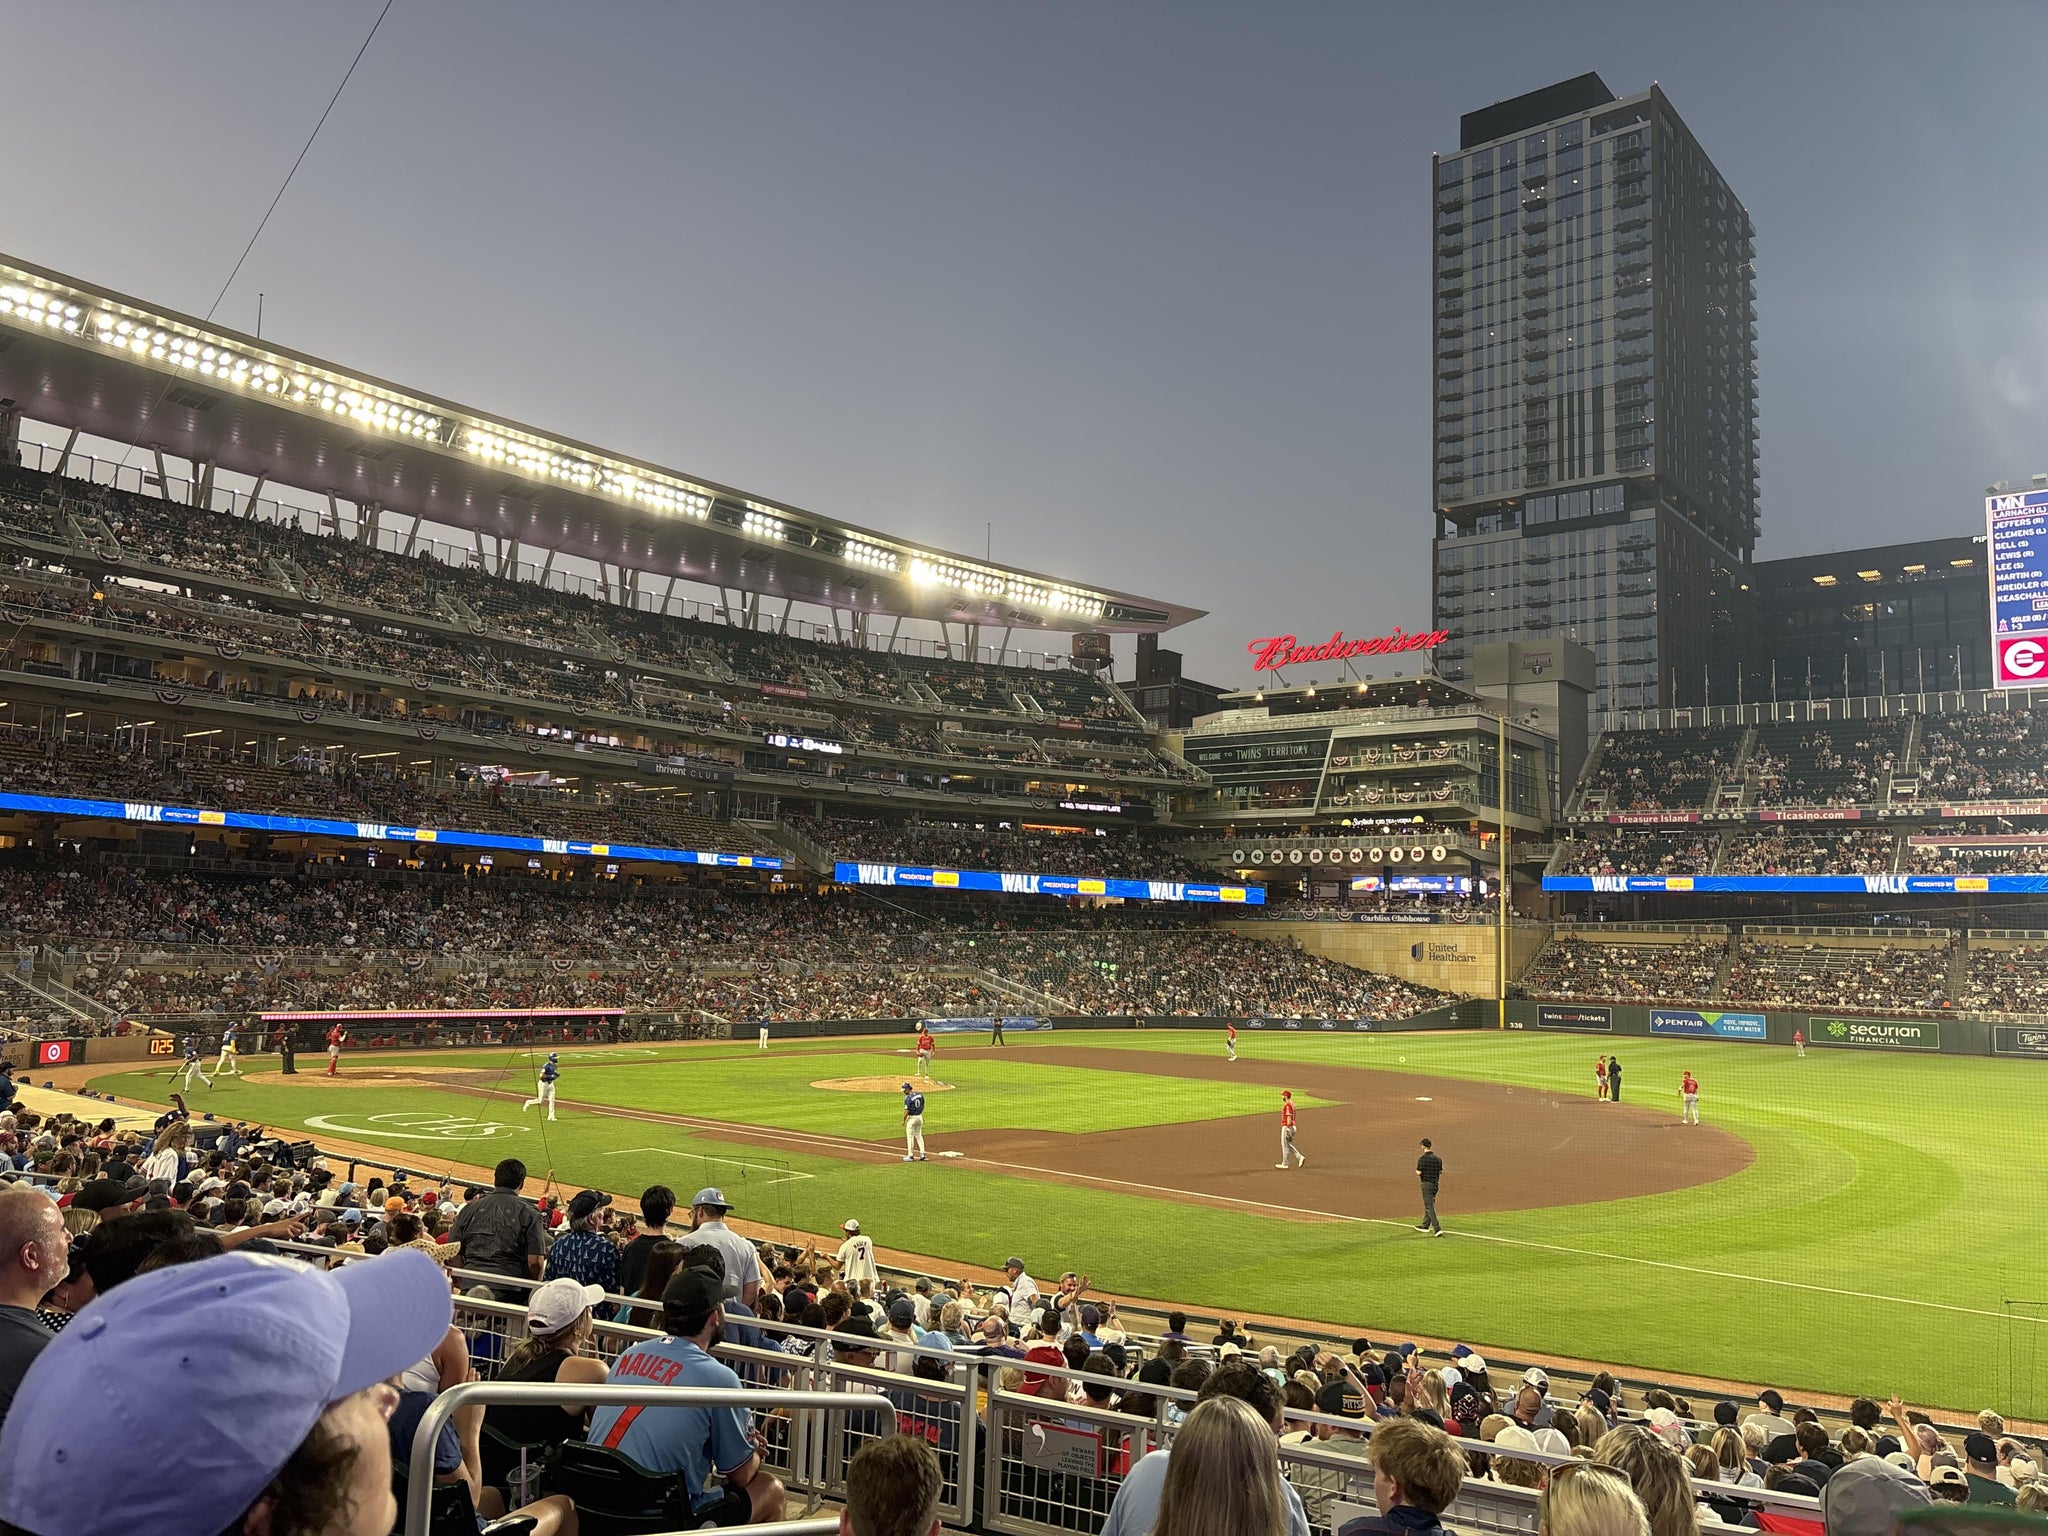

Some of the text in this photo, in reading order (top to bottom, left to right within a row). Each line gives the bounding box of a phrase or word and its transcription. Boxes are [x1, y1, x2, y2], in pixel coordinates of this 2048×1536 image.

[1996, 495, 2025, 510] MN
[1993, 506, 2047, 519] LARNACH (L)
[1994, 517, 2044, 529] JEFFERS (R)
[1994, 527, 2047, 540] CLEMENS (L)
[1995, 540, 2029, 551] BELL (S)
[1995, 550, 2034, 561] LEWIS (R)
[1996, 562, 2024, 571] LEE (S)
[1996, 571, 2030, 581] MARTIN
[1997, 581, 2039, 592] KREIDLER
[1997, 591, 2048, 603] KEASCHALL
[2011, 615, 2031, 623] SOLER
[2011, 622, 2023, 630] 1-3
[1079, 634, 1099, 646] Ford
[1083, 645, 1106, 655] Center
[1247, 626, 1449, 672] Budweiser
[1199, 752, 1222, 761] WELCOME
[1236, 748, 1262, 760] TWINS
[1267, 745, 1309, 757] TERRITORY
[655, 763, 719, 780] thrivent CLUB
[1223, 787, 1233, 797] WE
[1235, 785, 1247, 797] ARE
[1248, 785, 1261, 796] ALL
[124, 803, 162, 822] WALK
[1952, 805, 2041, 817] Treasure Island
[1618, 814, 1690, 823] Treasure Island
[357, 823, 387, 839] WALK
[542, 839, 568, 854] WALK
[697, 852, 719, 866] WALK
[1372, 851, 1380, 859] 14
[858, 864, 897, 885] WALK
[1000, 873, 1040, 893] WALK
[1591, 876, 1628, 892] WALK
[1863, 876, 1909, 893] WALK
[1148, 881, 1185, 901] WALK
[1360, 914, 1431, 923] Carbliss Clubhouse
[1428, 942, 1458, 952] United
[1428, 952, 1476, 963] Healthcare
[1544, 1013, 1606, 1022] twins.com/tickets
[1665, 1018, 1703, 1028] PENTAIR
[1849, 1024, 1921, 1038] securian
[1850, 1036, 1901, 1045] FINANCIAL
[2022, 1032, 2046, 1043] Twins
[150, 1039, 174, 1054] 025
[914, 1098, 921, 1108] 0
[857, 1246, 865, 1260] 7
[614, 1352, 684, 1387] MAUER
[1071, 1446, 1095, 1456] BEWARE
[1071, 1452, 1095, 1462] OBJECTS
[1061, 1456, 1084, 1466] LEAVING
[1057, 1462, 1095, 1474] PLAYING FIELD
